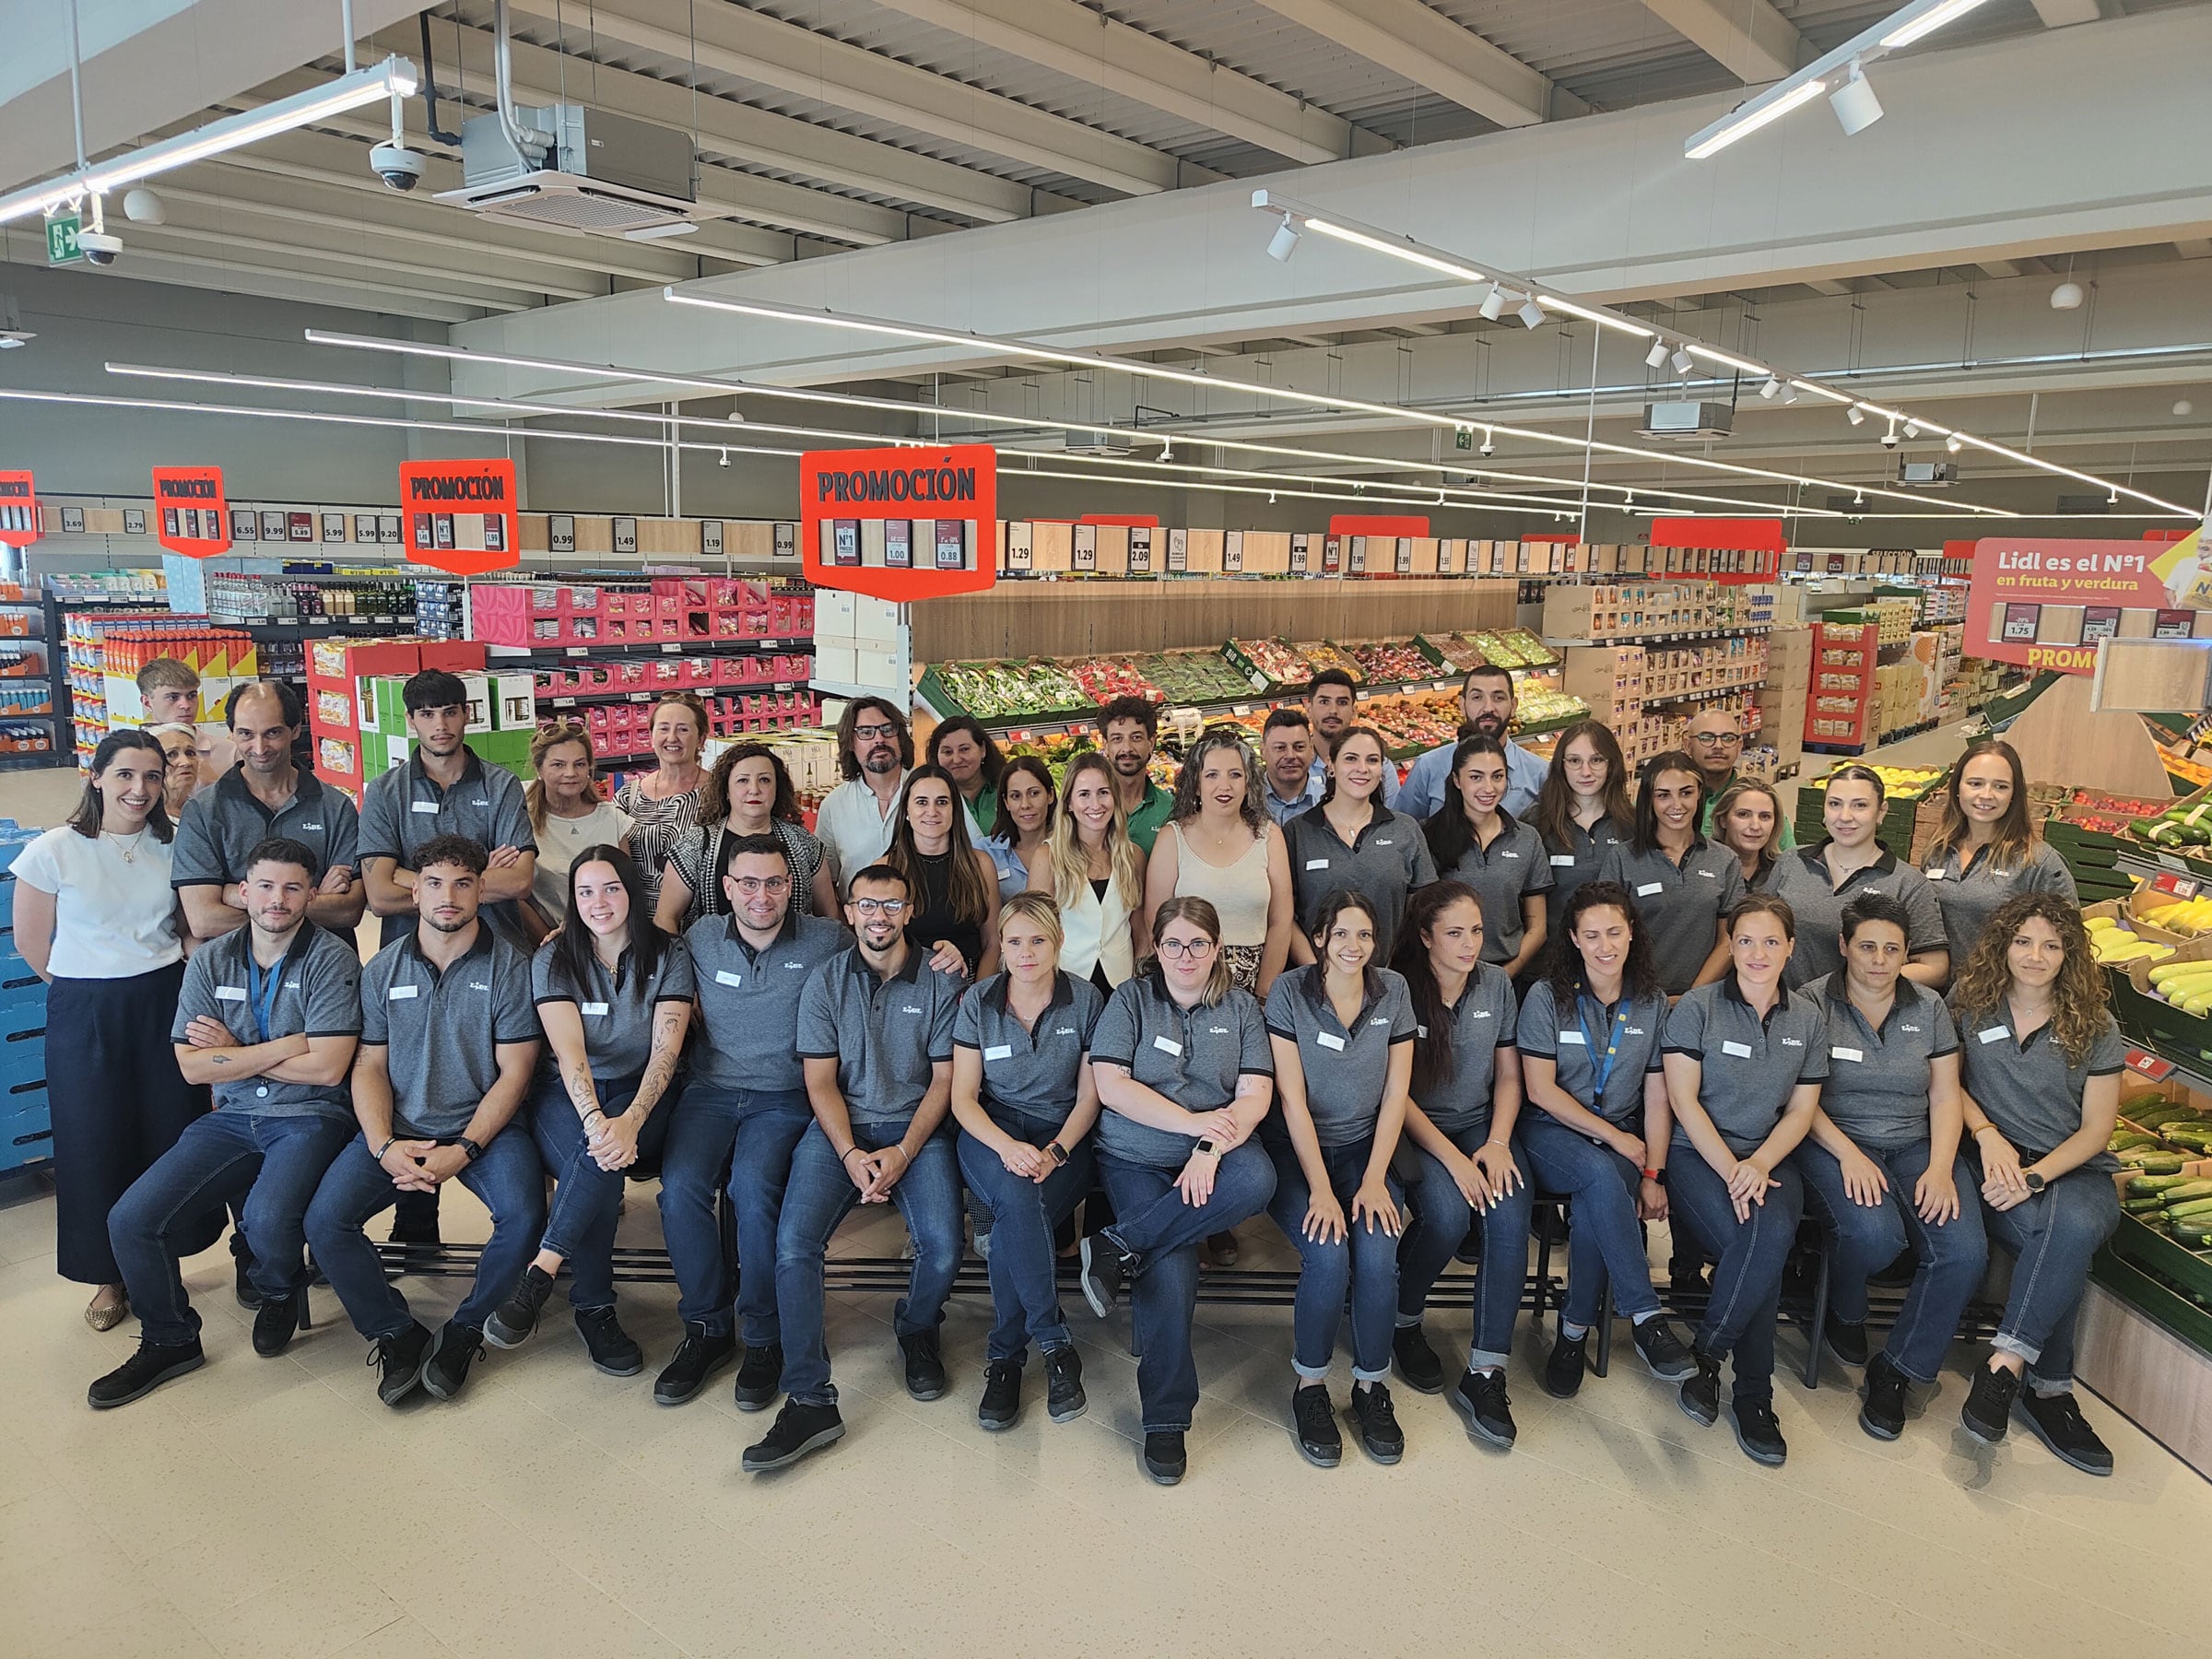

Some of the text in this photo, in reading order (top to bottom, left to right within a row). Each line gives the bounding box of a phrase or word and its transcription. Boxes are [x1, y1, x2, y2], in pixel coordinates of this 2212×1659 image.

[410, 467, 504, 500] PROMOCIÓN
[817, 456, 975, 501] PROMOCIÓN
[159, 473, 217, 499] PROMOCIÓN
[237, 526, 254, 535] 6.55
[553, 535, 573, 545] 0.99
[617, 536, 634, 546] 1.49
[706, 538, 721, 547] 1.19
[777, 540, 793, 549] 0.99
[889, 550, 905, 559] 1.00
[940, 551, 958, 560] 0.88
[1011, 547, 1030, 559] 1.29
[1077, 549, 1093, 560] 1.29
[1132, 551, 1148, 561] 2.09
[1228, 553, 1241, 562] 1.49
[1293, 554, 1305, 563] 1.99
[1353, 555, 1364, 564] 1.99
[1998, 551, 2041, 570] Lidl
[2046, 557, 2071, 571] es
[2076, 553, 2098, 571] el
[1996, 574, 2138, 591] en fruta y verdura
